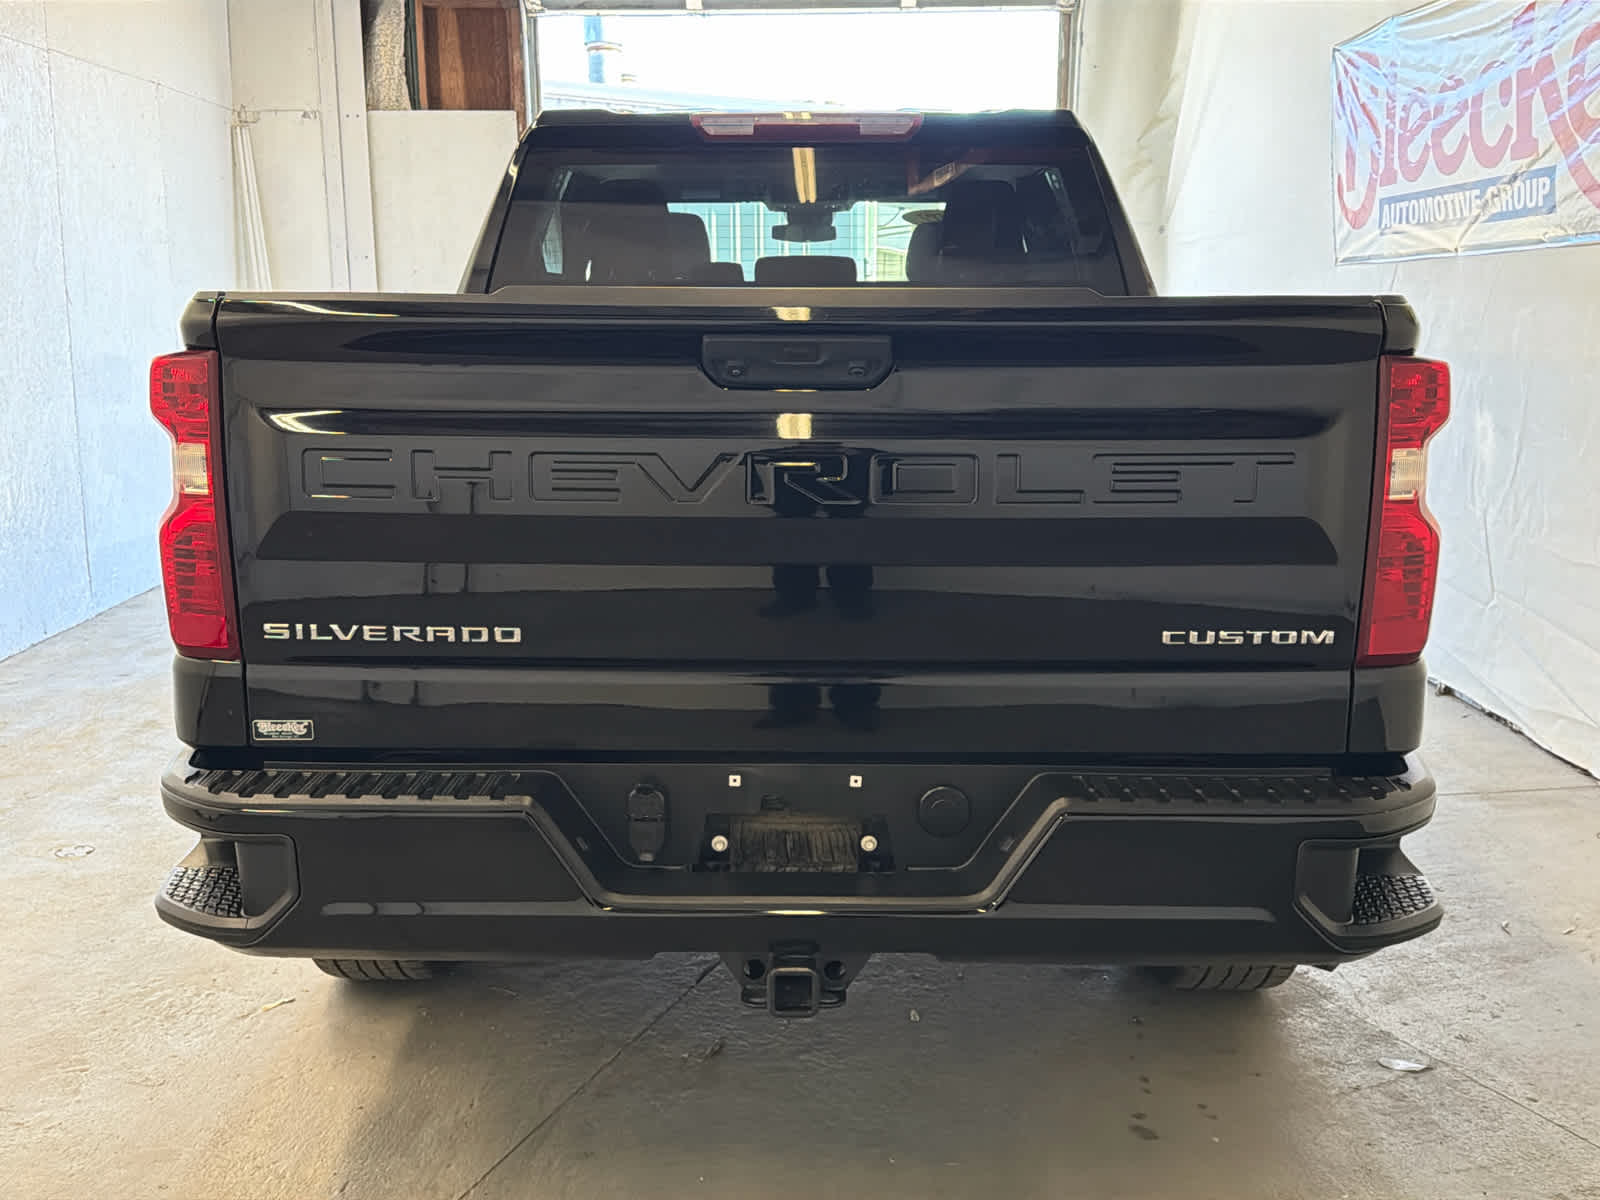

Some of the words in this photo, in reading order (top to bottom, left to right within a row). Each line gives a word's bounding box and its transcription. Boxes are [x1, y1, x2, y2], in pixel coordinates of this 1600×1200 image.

[1380, 188, 1482, 230] AUTOMOTIVE
[1485, 175, 1551, 216] GROUP
[302, 446, 1296, 506] CHEVROLET
[262, 622, 523, 644] SILVERADO
[1161, 629, 1336, 646] CUSTOM
